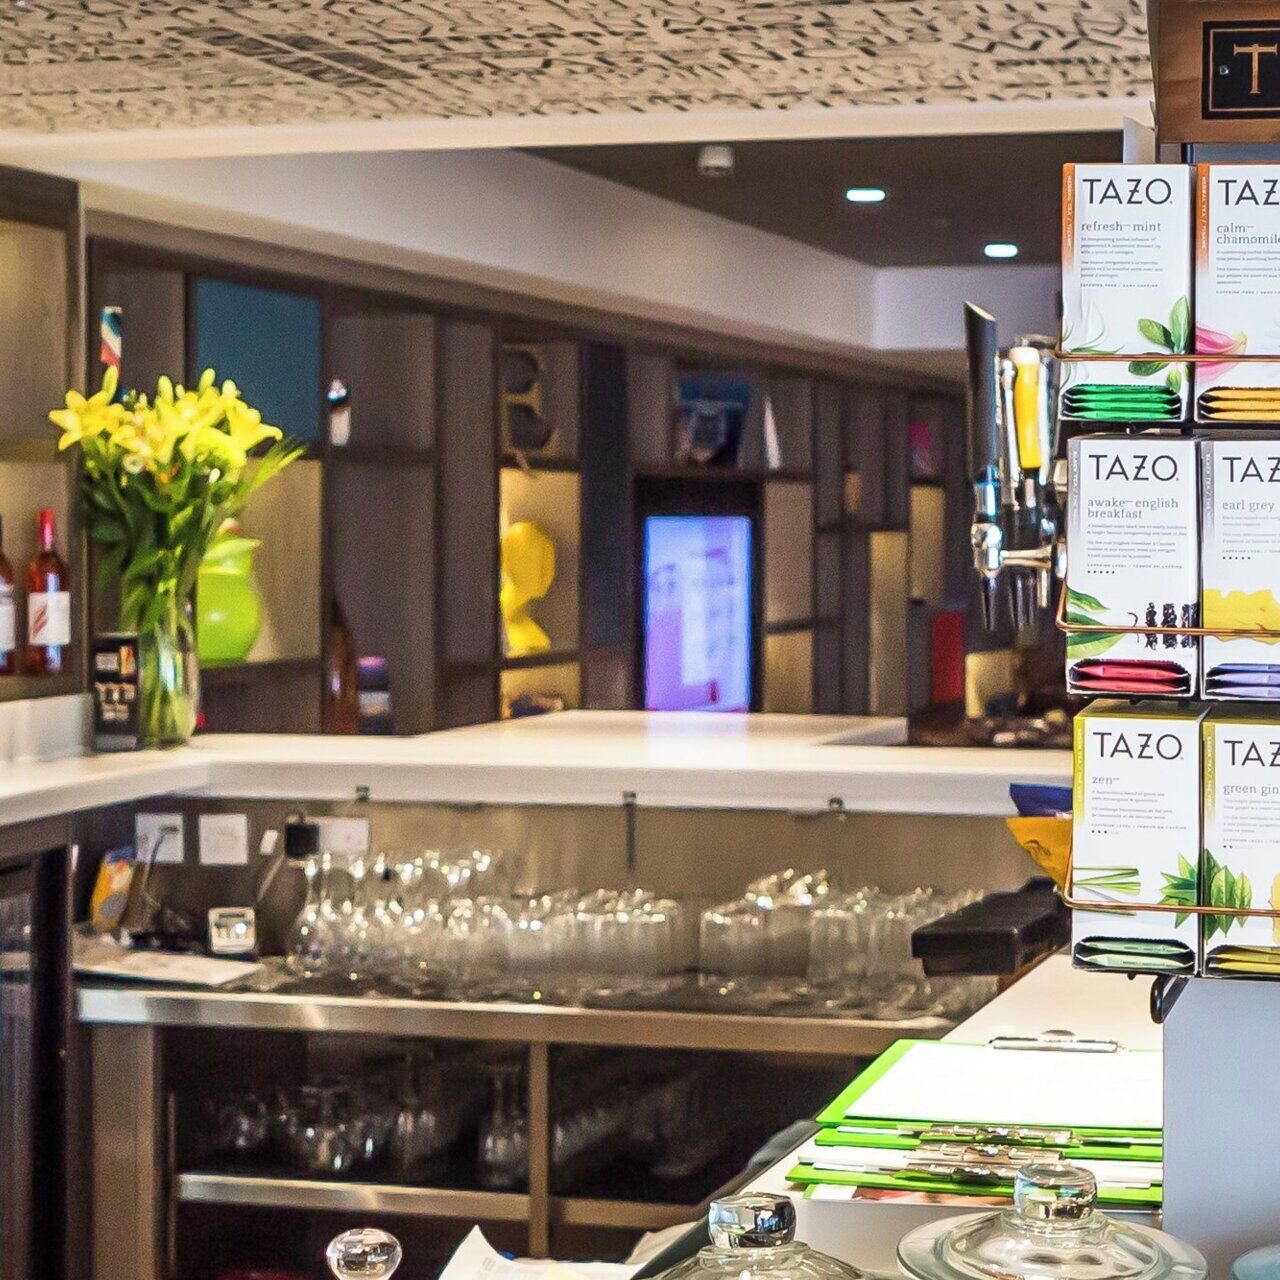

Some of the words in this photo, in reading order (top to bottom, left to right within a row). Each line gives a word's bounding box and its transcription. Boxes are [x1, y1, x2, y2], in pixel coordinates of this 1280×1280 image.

[1082, 178, 1172, 205] TAZO
[1133, 222, 1161, 232] mint
[1088, 454, 1178, 482] TAZO
[1135, 498, 1179, 510] english
[1222, 500, 1245, 510] earl
[1249, 502, 1275, 513] grey
[1087, 508, 1142, 518] breakfast
[1093, 732, 1182, 760] TAZO
[1092, 776, 1112, 785] zen
[1223, 784, 1257, 796] green
